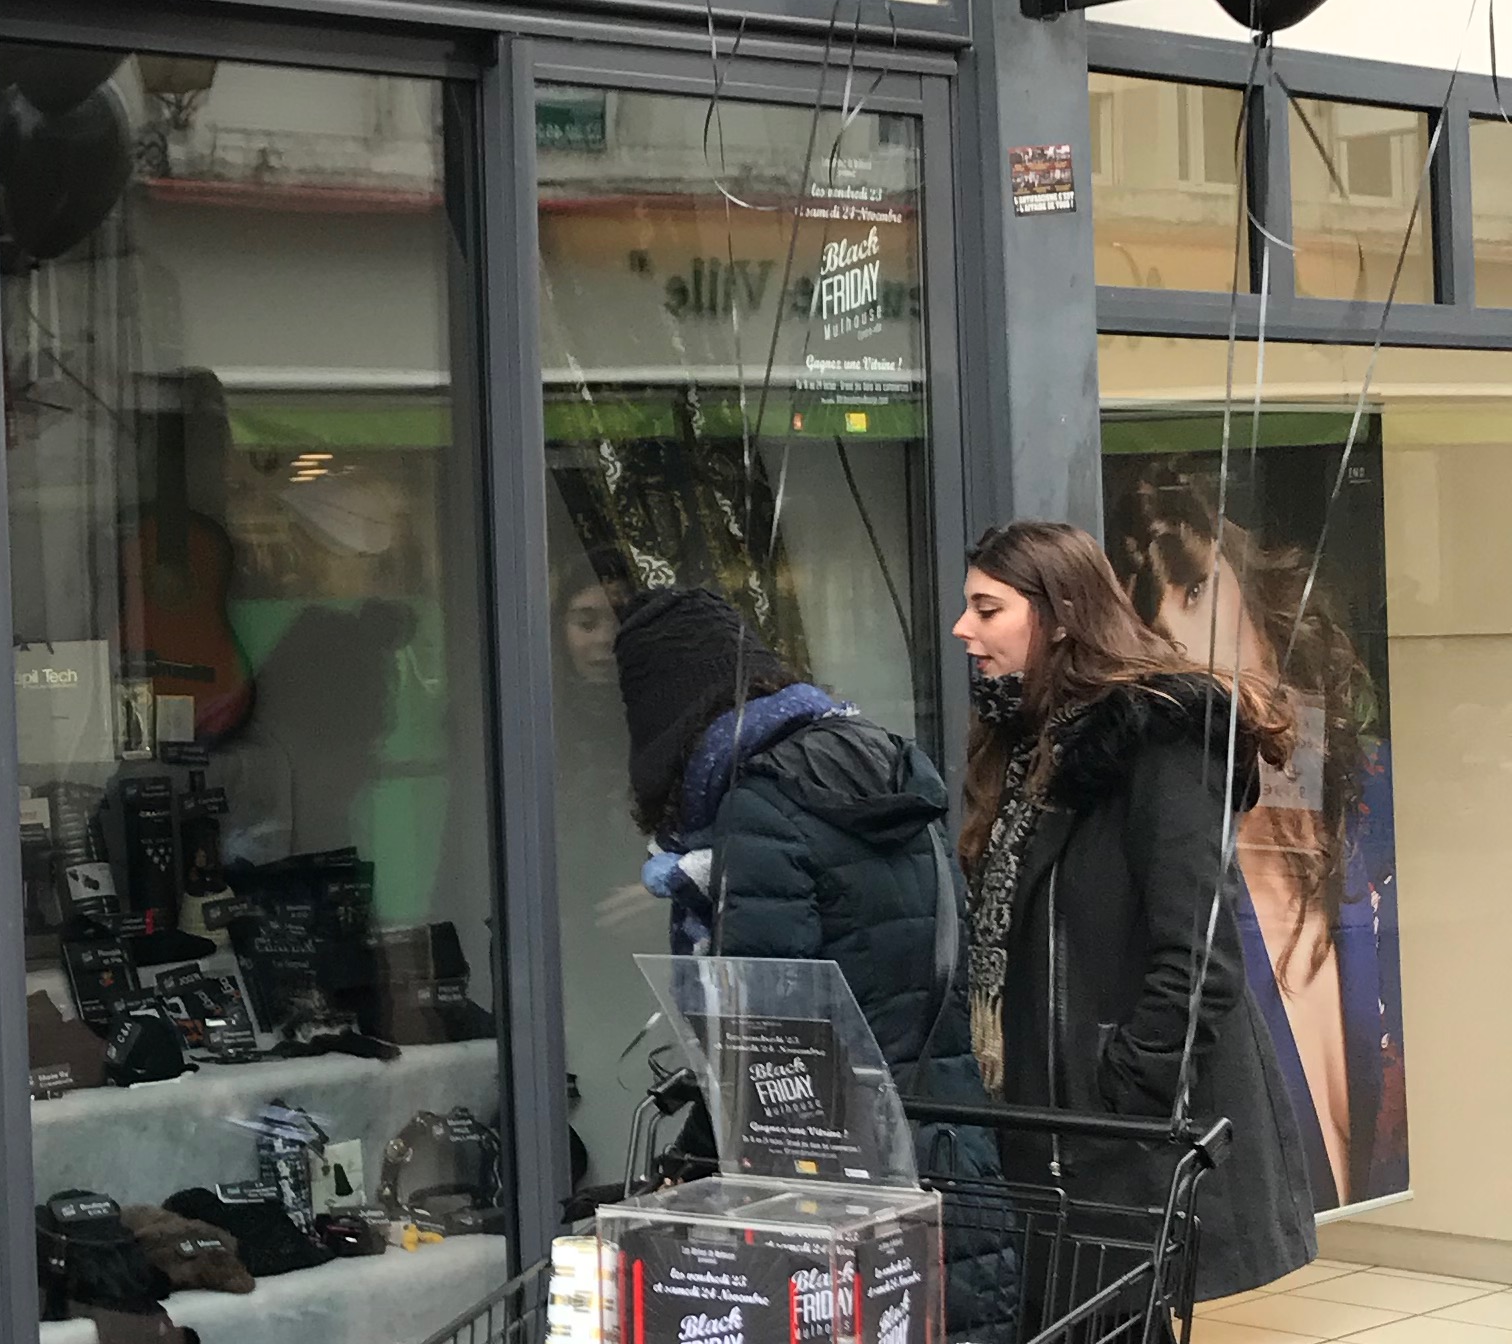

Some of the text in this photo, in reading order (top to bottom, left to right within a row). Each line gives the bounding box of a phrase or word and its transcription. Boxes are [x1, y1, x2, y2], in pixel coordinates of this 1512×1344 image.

[820, 226, 881, 276] Black
[822, 260, 881, 320] FRIDAY
[823, 305, 883, 341] Mulhouse
[14, 668, 78, 689] pil Tech
[749, 1056, 807, 1081] Black
[755, 1074, 815, 1105] FRIDAY
[677, 1306, 744, 1341] Black
